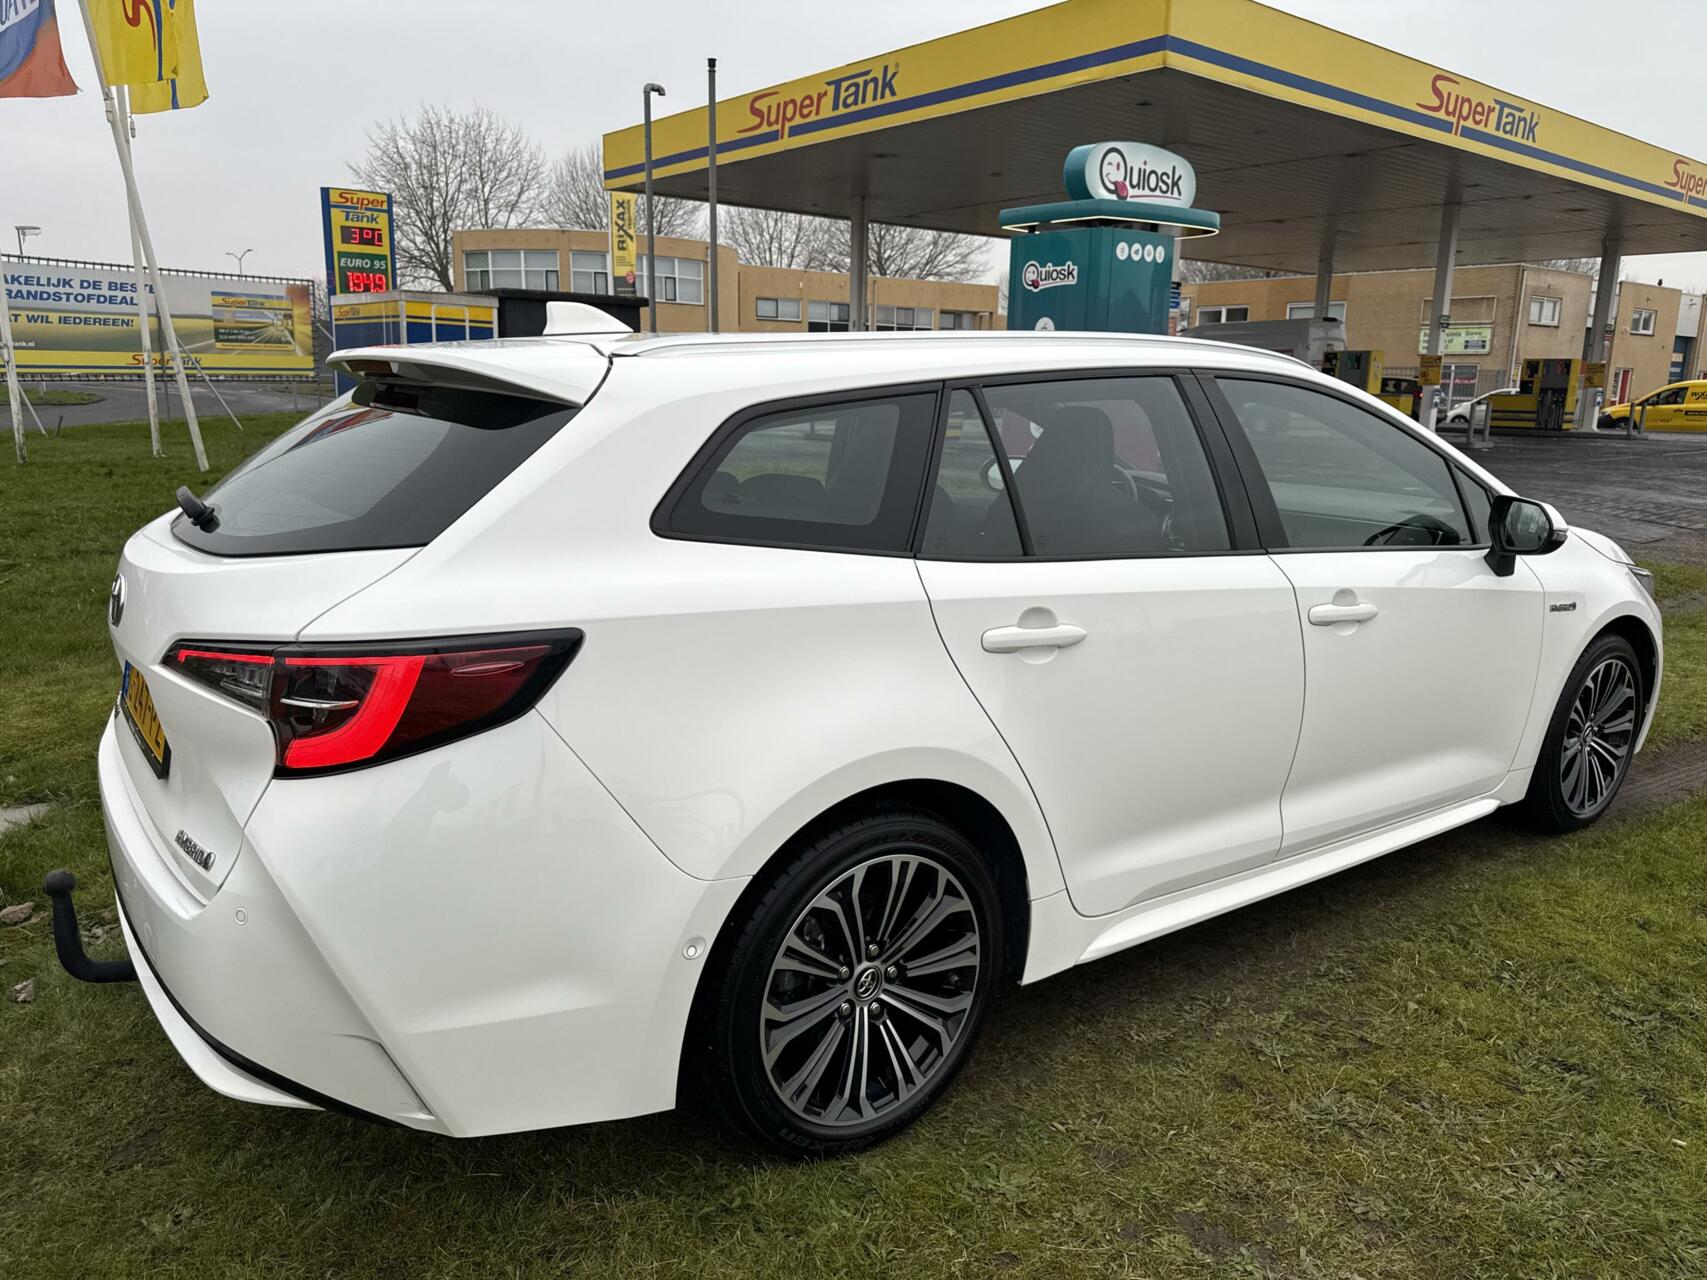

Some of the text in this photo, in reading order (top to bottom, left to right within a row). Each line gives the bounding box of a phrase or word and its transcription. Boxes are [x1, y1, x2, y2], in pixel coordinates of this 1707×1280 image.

[737, 64, 899, 140] SuperTank
[1416, 74, 1540, 143] SuperTank
[1100, 147, 1182, 200] Quiosk
[338, 191, 387, 211] Super
[340, 209, 379, 224] Tank
[340, 257, 387, 270] EURO 95
[79, 279, 103, 291] DE
[1023, 262, 1076, 288] Quiosk
[26, 314, 54, 325] WIL
[58, 315, 134, 327] IEDEREEN!
